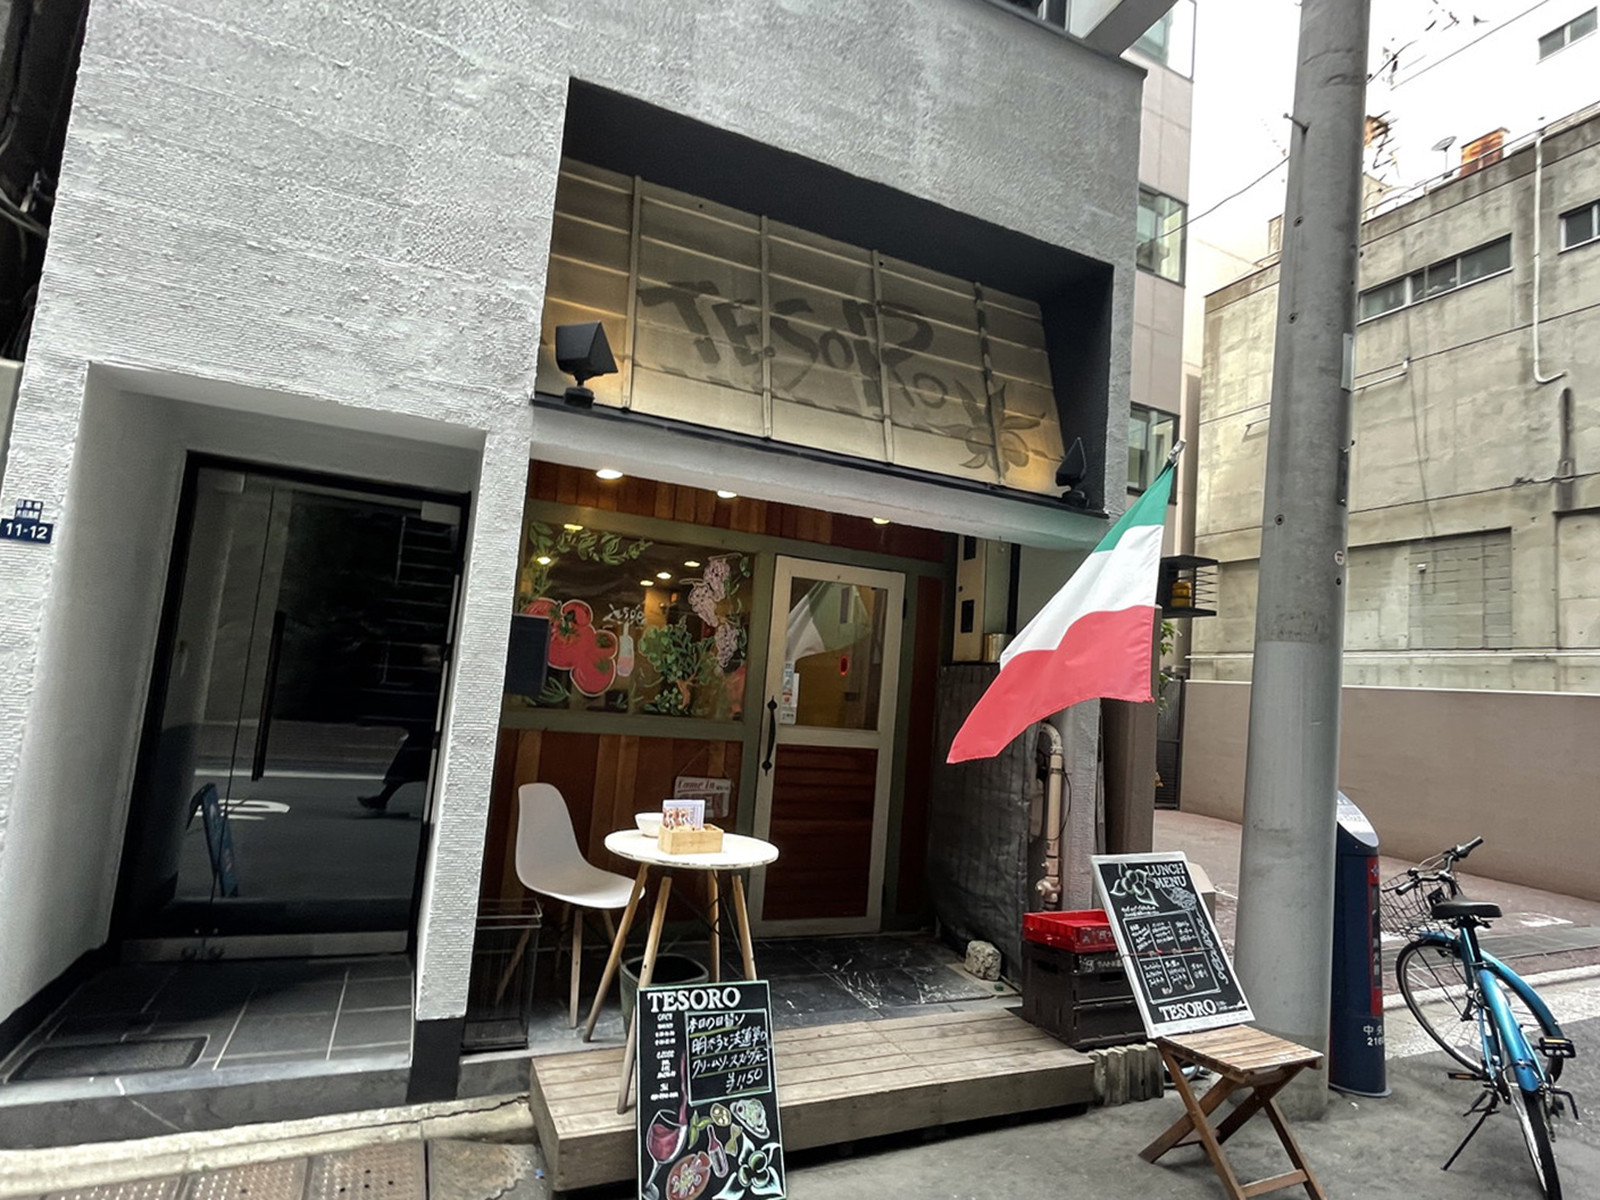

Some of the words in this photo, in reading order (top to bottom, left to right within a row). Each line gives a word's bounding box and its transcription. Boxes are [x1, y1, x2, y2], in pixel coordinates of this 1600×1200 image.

[5, 522, 48, 539] 11-12
[1145, 863, 1185, 876] LUNCH
[1154, 875, 1187, 889] MENU
[647, 986, 741, 1013] TESORO
[1159, 999, 1217, 1021] TESORO
